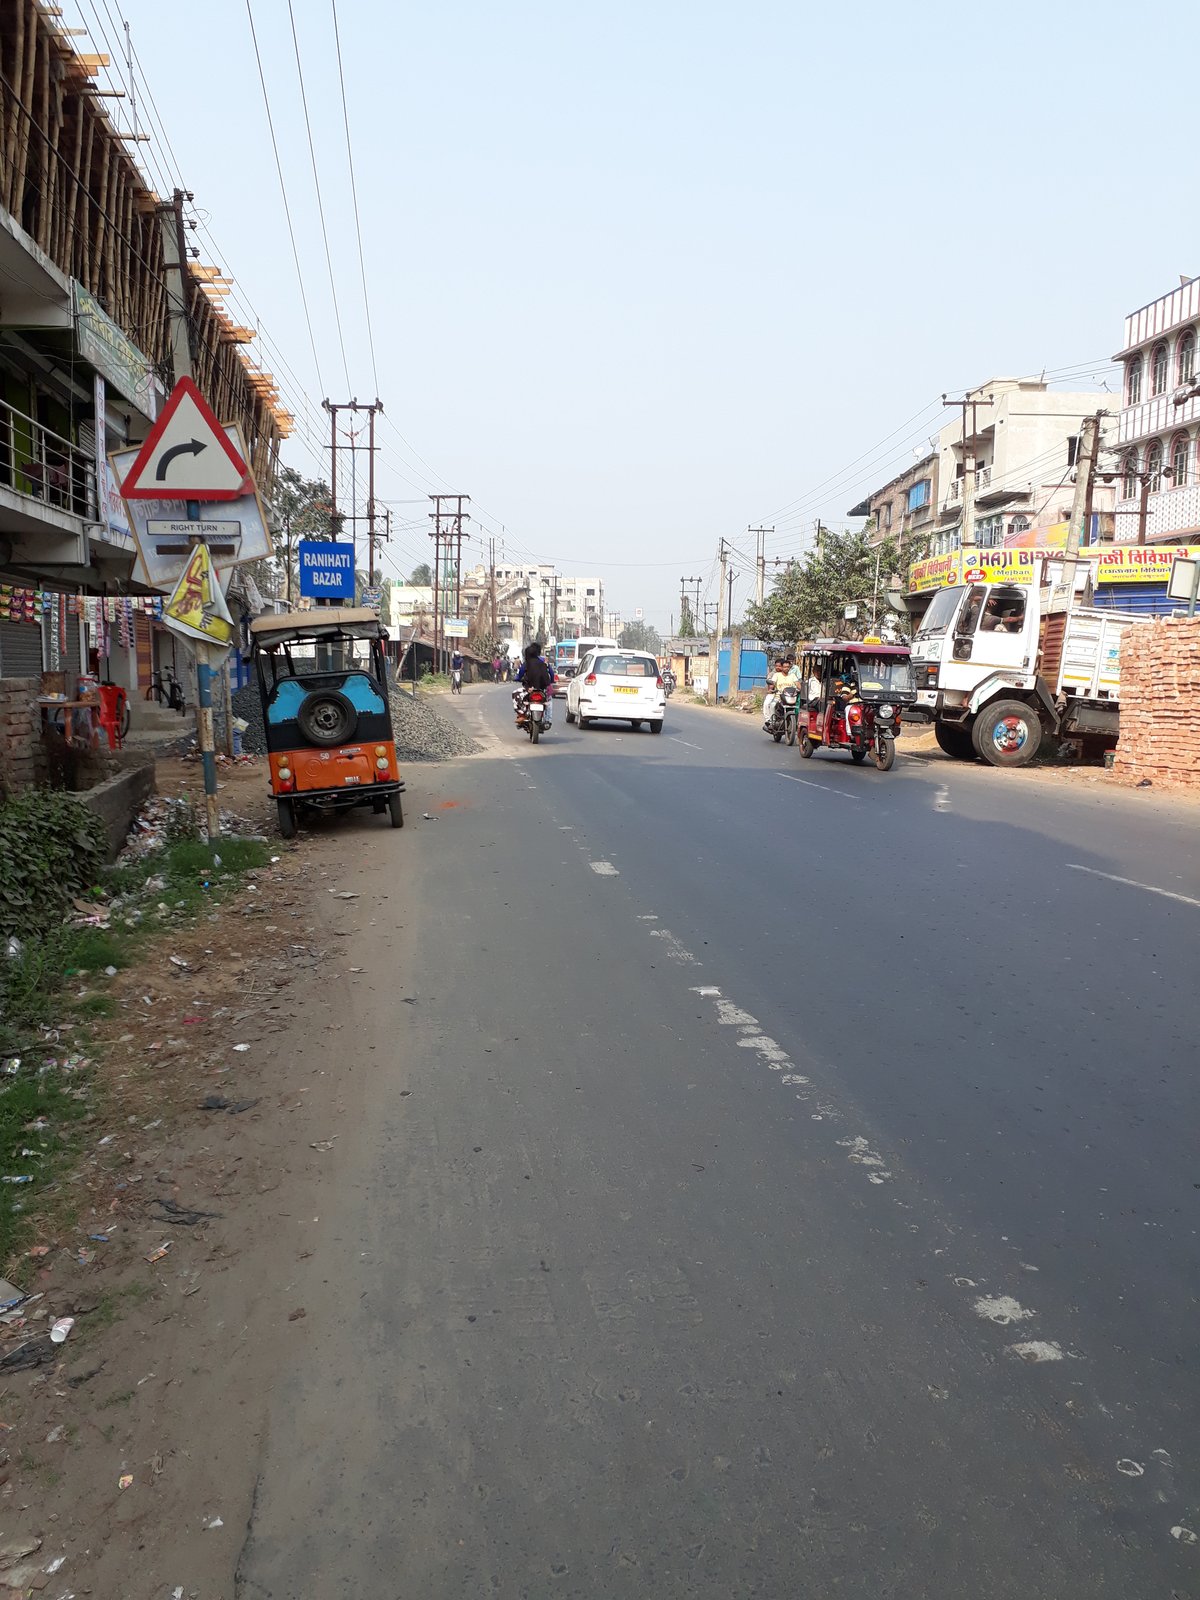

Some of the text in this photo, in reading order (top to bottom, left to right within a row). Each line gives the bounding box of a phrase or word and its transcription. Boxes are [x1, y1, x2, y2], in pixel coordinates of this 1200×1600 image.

[303, 553, 351, 568] RANIHATI
[979, 551, 1013, 568] HAJI
[312, 571, 343, 586] BAZAR
